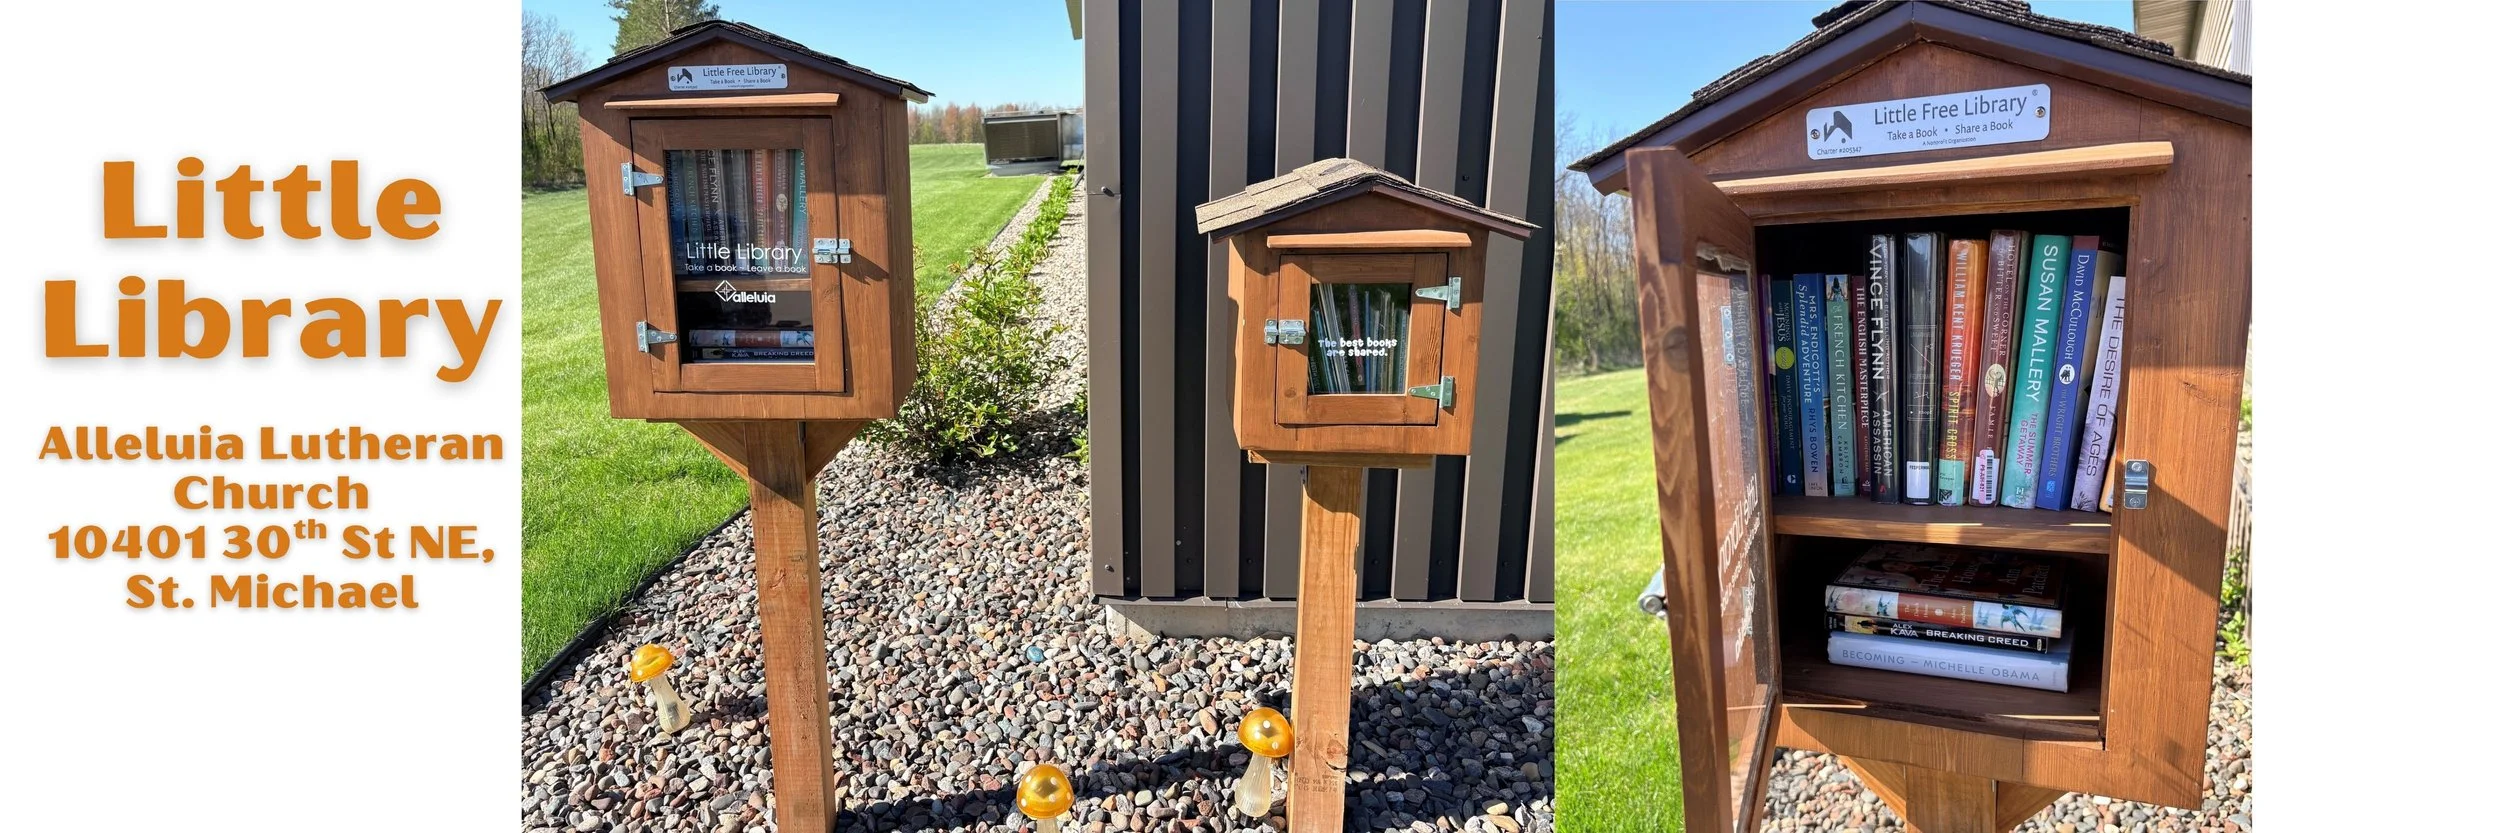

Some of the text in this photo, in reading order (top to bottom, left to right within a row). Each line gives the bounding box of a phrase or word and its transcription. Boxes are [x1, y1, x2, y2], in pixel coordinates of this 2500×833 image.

[702, 66, 777, 78] Little Free Library
[1874, 95, 2028, 125] Little Free Library
[1887, 120, 2014, 141] Take a Book Share a Book
[709, 168, 720, 203] FLYNN
[685, 263, 704, 272] Take
[714, 264, 737, 272] book
[747, 265, 774, 273] Leave
[784, 265, 807, 273] book
[686, 242, 802, 264] Little Library
[2006, 246, 2015, 282] HOTEL
[2074, 254, 2090, 286] DAVID
[732, 291, 776, 303] alleluia
[1995, 261, 2004, 300] BITTER
[1775, 312, 1786, 342] JESUS
[1869, 243, 1884, 380] VINCE FLYNN
[1950, 251, 1968, 380] WILLIAM KENT KRUEGER
[2026, 244, 2058, 403] SUSAN MALLERY
[1318, 336, 1398, 348] The best books
[1326, 346, 1388, 356] are shared.
[1796, 284, 1812, 404] Splendid ADVENTURE
[1809, 296, 1820, 393] MRS. ENDICOTT'S
[1834, 316, 1844, 368] FRENCH
[1990, 317, 2000, 351] SWEET
[2000, 312, 2010, 356] CORNER
[1856, 287, 1869, 428] THE ENGLISH MASTERPIECE
[2100, 336, 2120, 400] DESIRE
[1836, 374, 1848, 430] KITCHEN
[1948, 391, 1960, 424] SPIRIT
[2056, 400, 2067, 432] WRIGHT
[2096, 404, 2108, 427] OF
[1808, 408, 1816, 432] RHYS
[1988, 406, 1996, 440] JAMIE
[1810, 437, 1818, 473] BOWEN
[1872, 410, 1882, 474] ASSASSIN
[1883, 409, 1892, 476] AMERICAN
[1946, 429, 1958, 460] CROSS
[2016, 420, 2028, 466] GETAWAY
[2024, 413, 2038, 475] THE SUMMER
[2048, 436, 2062, 477] BROTHERS
[2086, 430, 2103, 477] AGES
[1890, 628, 2029, 647] KAVA BREAKING CREED
[1842, 650, 1905, 665] BECOMING
[1923, 660, 1985, 675] MICHELLE
[1991, 667, 2040, 682] OBAMA
